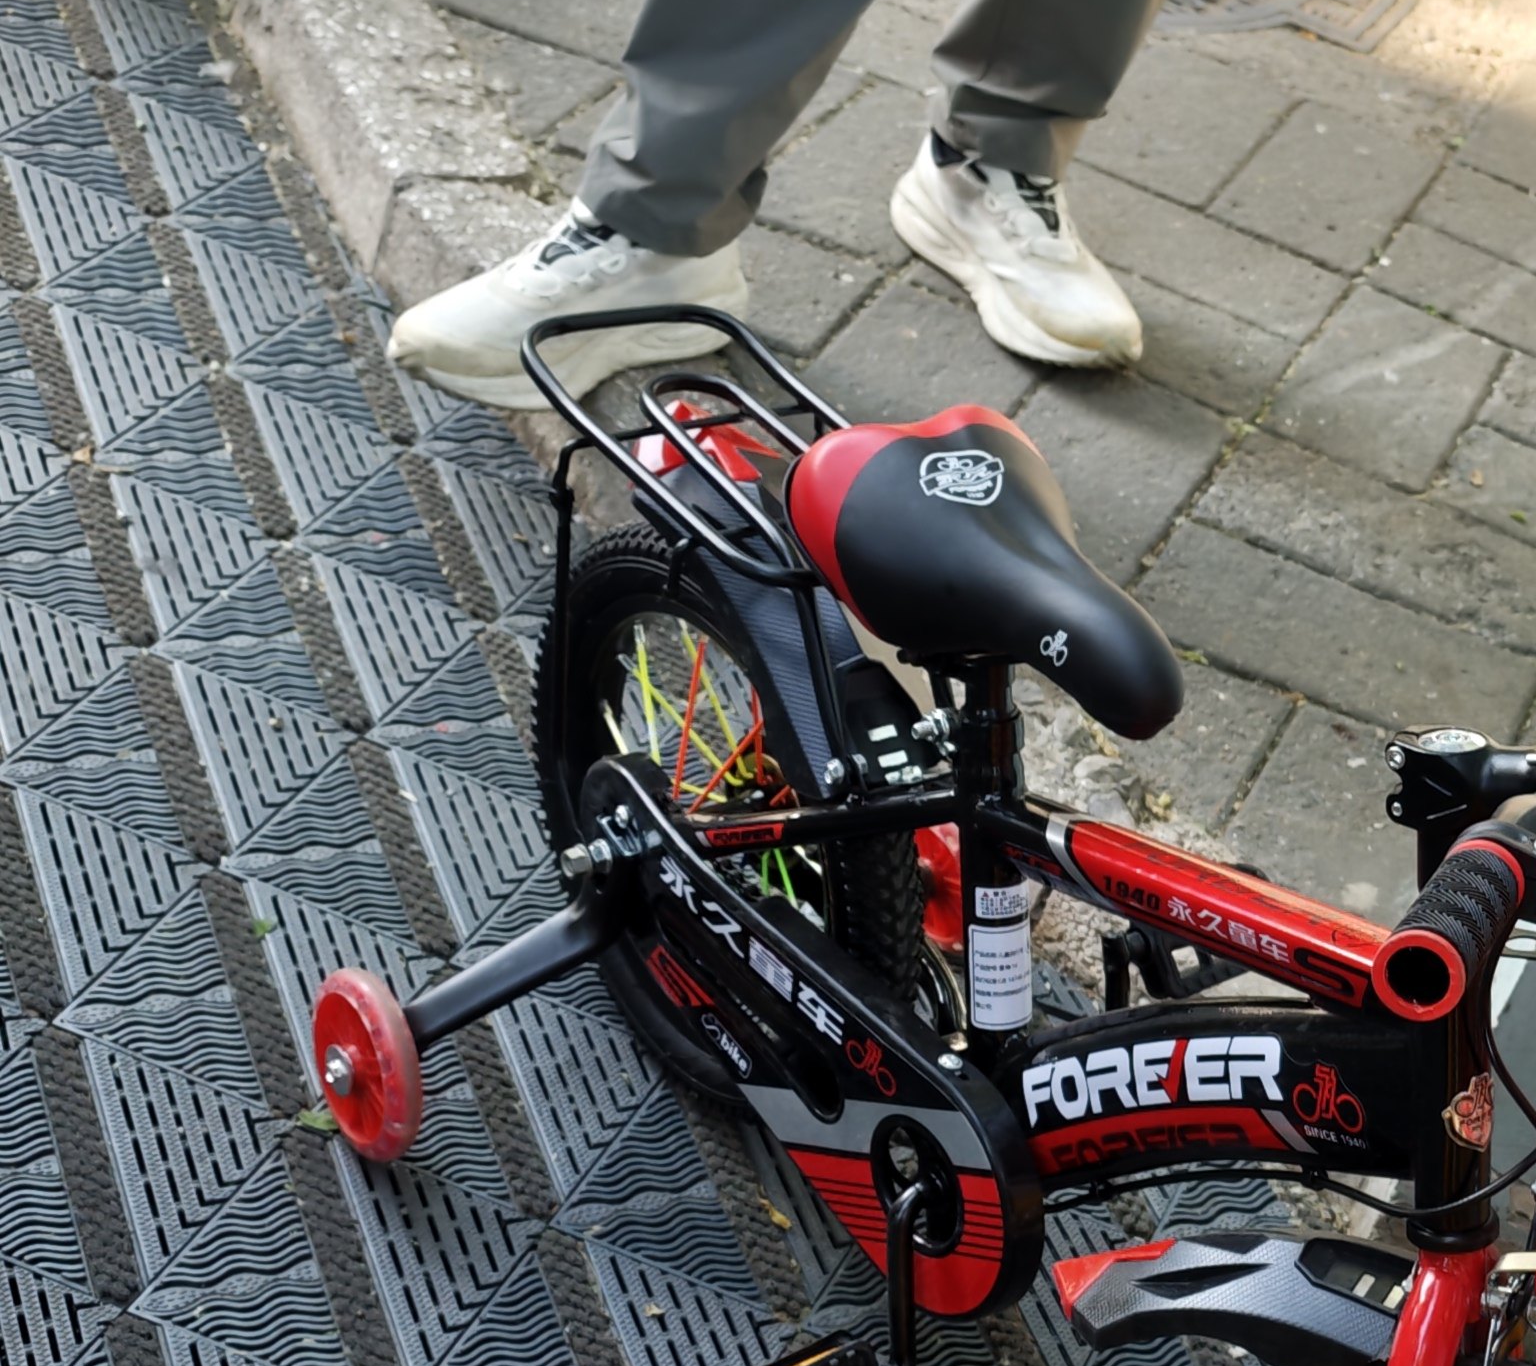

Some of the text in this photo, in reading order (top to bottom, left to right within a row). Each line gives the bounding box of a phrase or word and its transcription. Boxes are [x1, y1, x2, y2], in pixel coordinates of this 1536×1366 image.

[659, 855, 845, 1046] 永久童车
[1101, 873, 1161, 912] 1940
[1166, 895, 1290, 964] 永久童车
[1022, 1035, 1284, 1129] FOREVER
[1303, 1124, 1367, 1150] SINCE 1940
